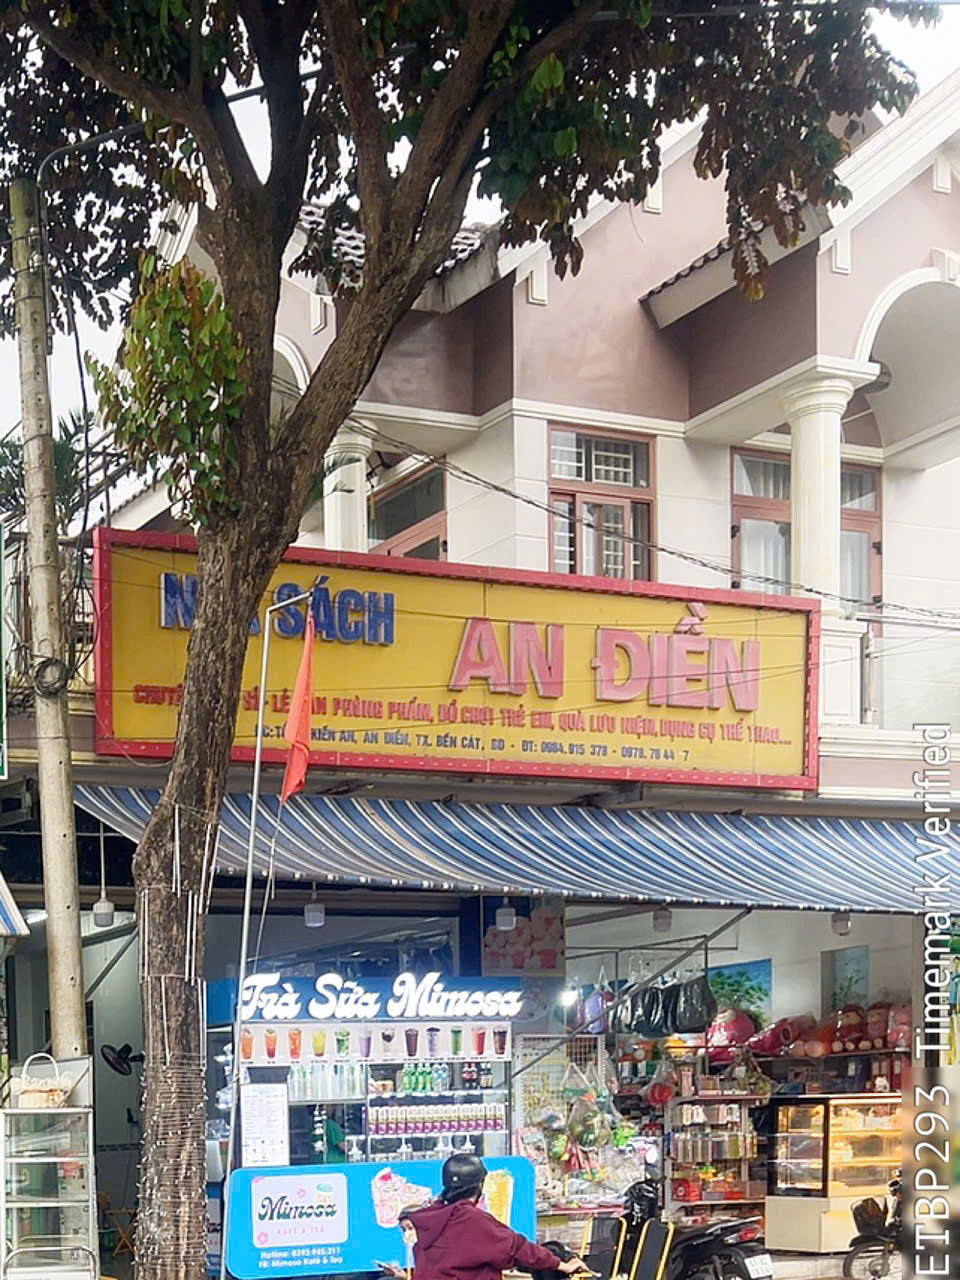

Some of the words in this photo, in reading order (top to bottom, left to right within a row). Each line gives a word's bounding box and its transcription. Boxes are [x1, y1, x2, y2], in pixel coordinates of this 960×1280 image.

[273, 575, 395, 647] SÁCH
[447, 616, 565, 699] AN
[590, 601, 761, 713] ĐIỀN
[240, 972, 302, 1020] Trà
[308, 972, 381, 1020] Sữa
[387, 971, 524, 1020] Mimosa
[258, 1195, 338, 1221] Mimosa
